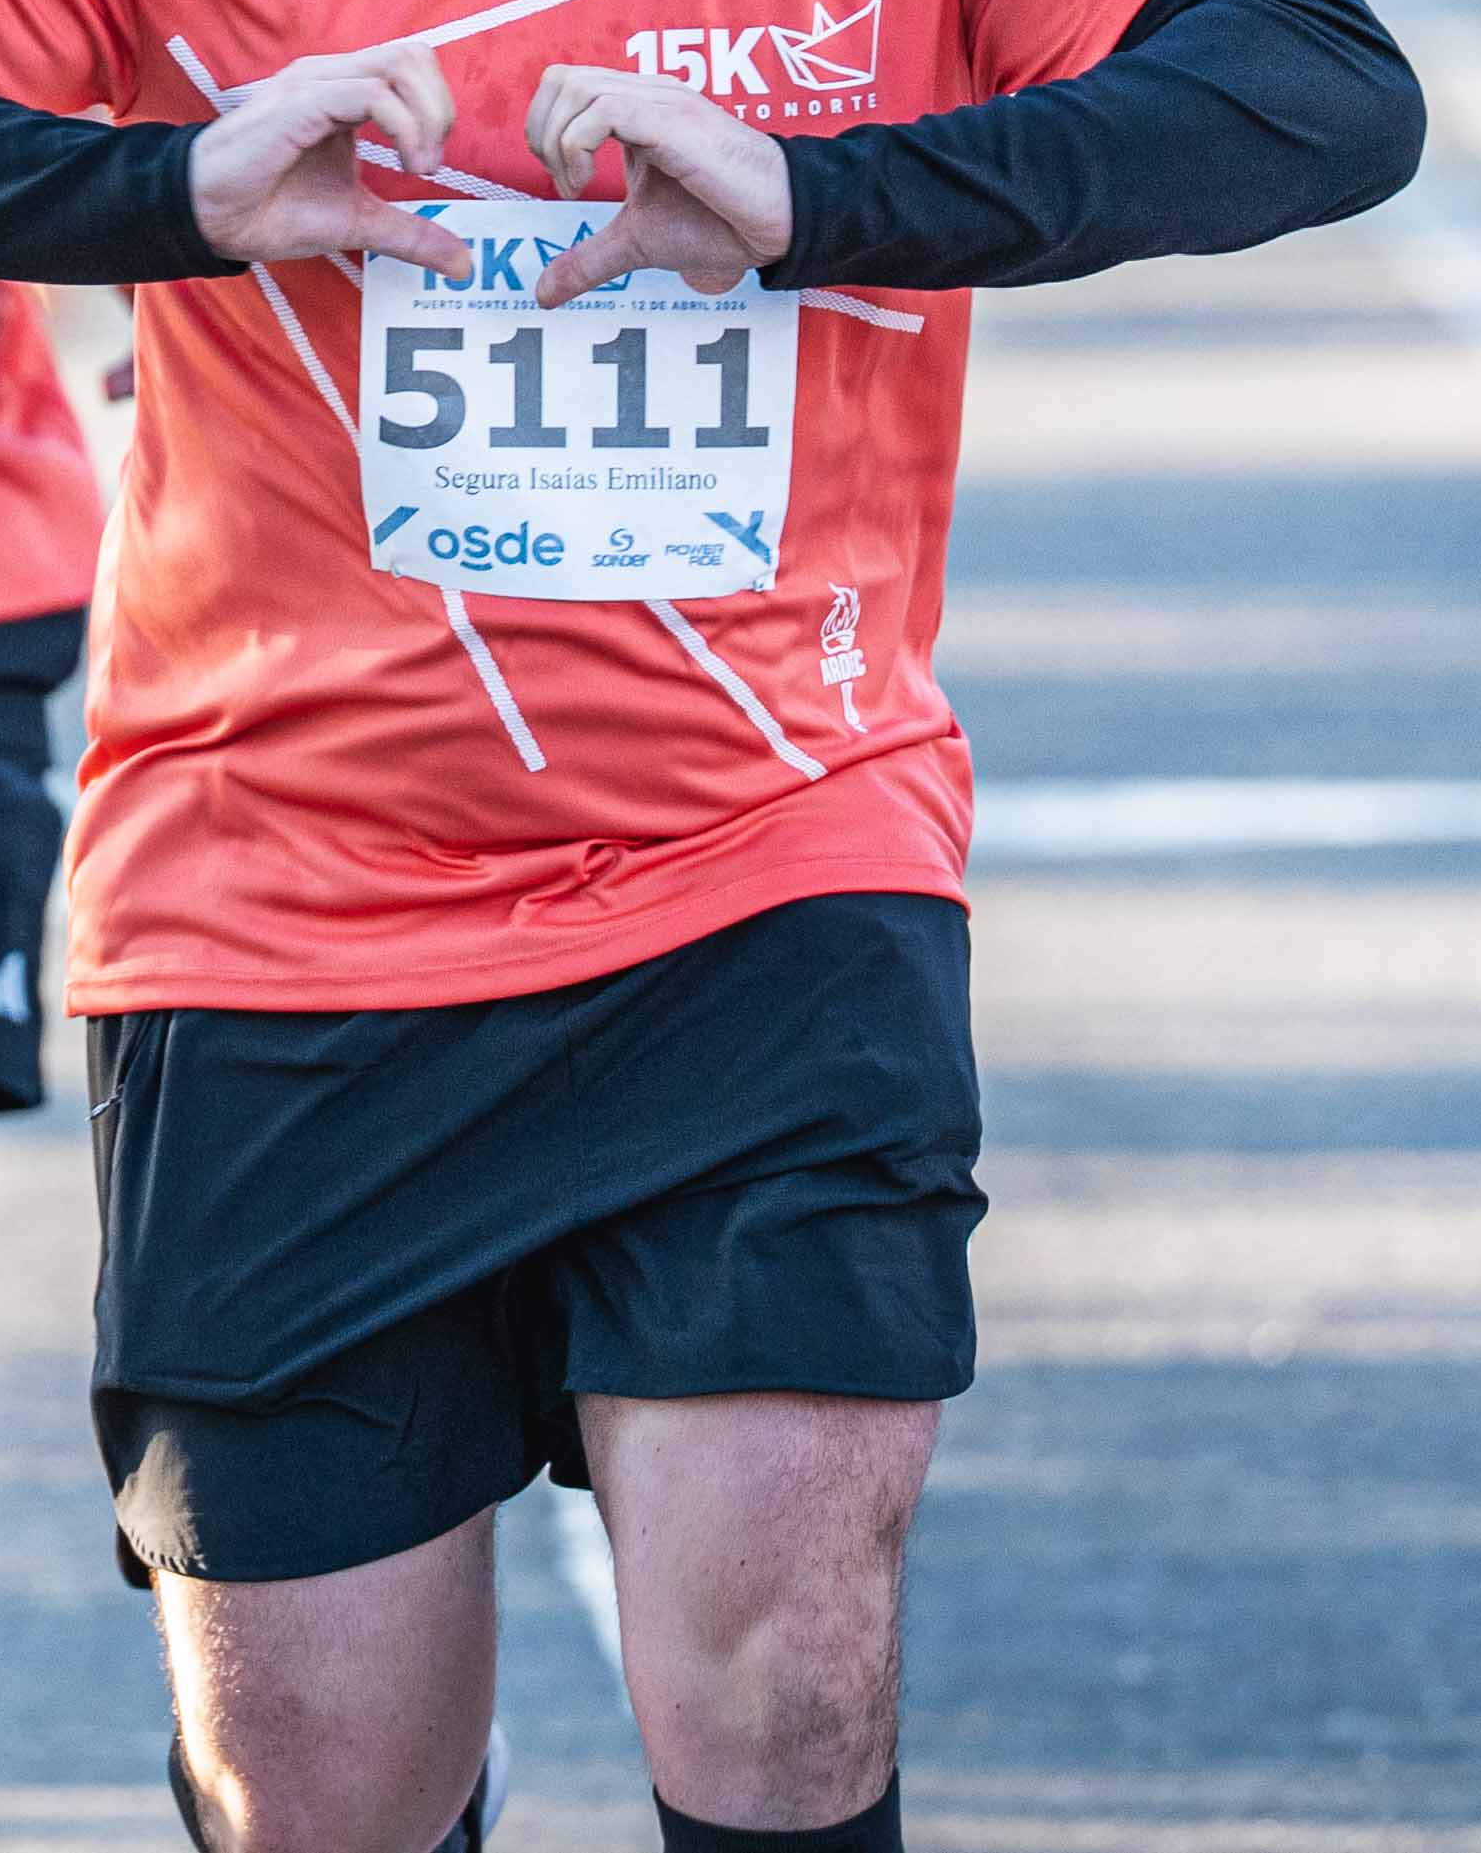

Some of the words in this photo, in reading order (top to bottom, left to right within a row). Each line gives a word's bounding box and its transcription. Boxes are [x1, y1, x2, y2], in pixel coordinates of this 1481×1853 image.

[625, 26, 770, 96] 15K
[784, 93, 877, 118] NORTE
[379, 327, 770, 450] 5111
[435, 465, 520, 495] Segura
[530, 465, 598, 491] Isaías
[607, 465, 718, 491] Emiliano
[427, 520, 565, 571] osde
